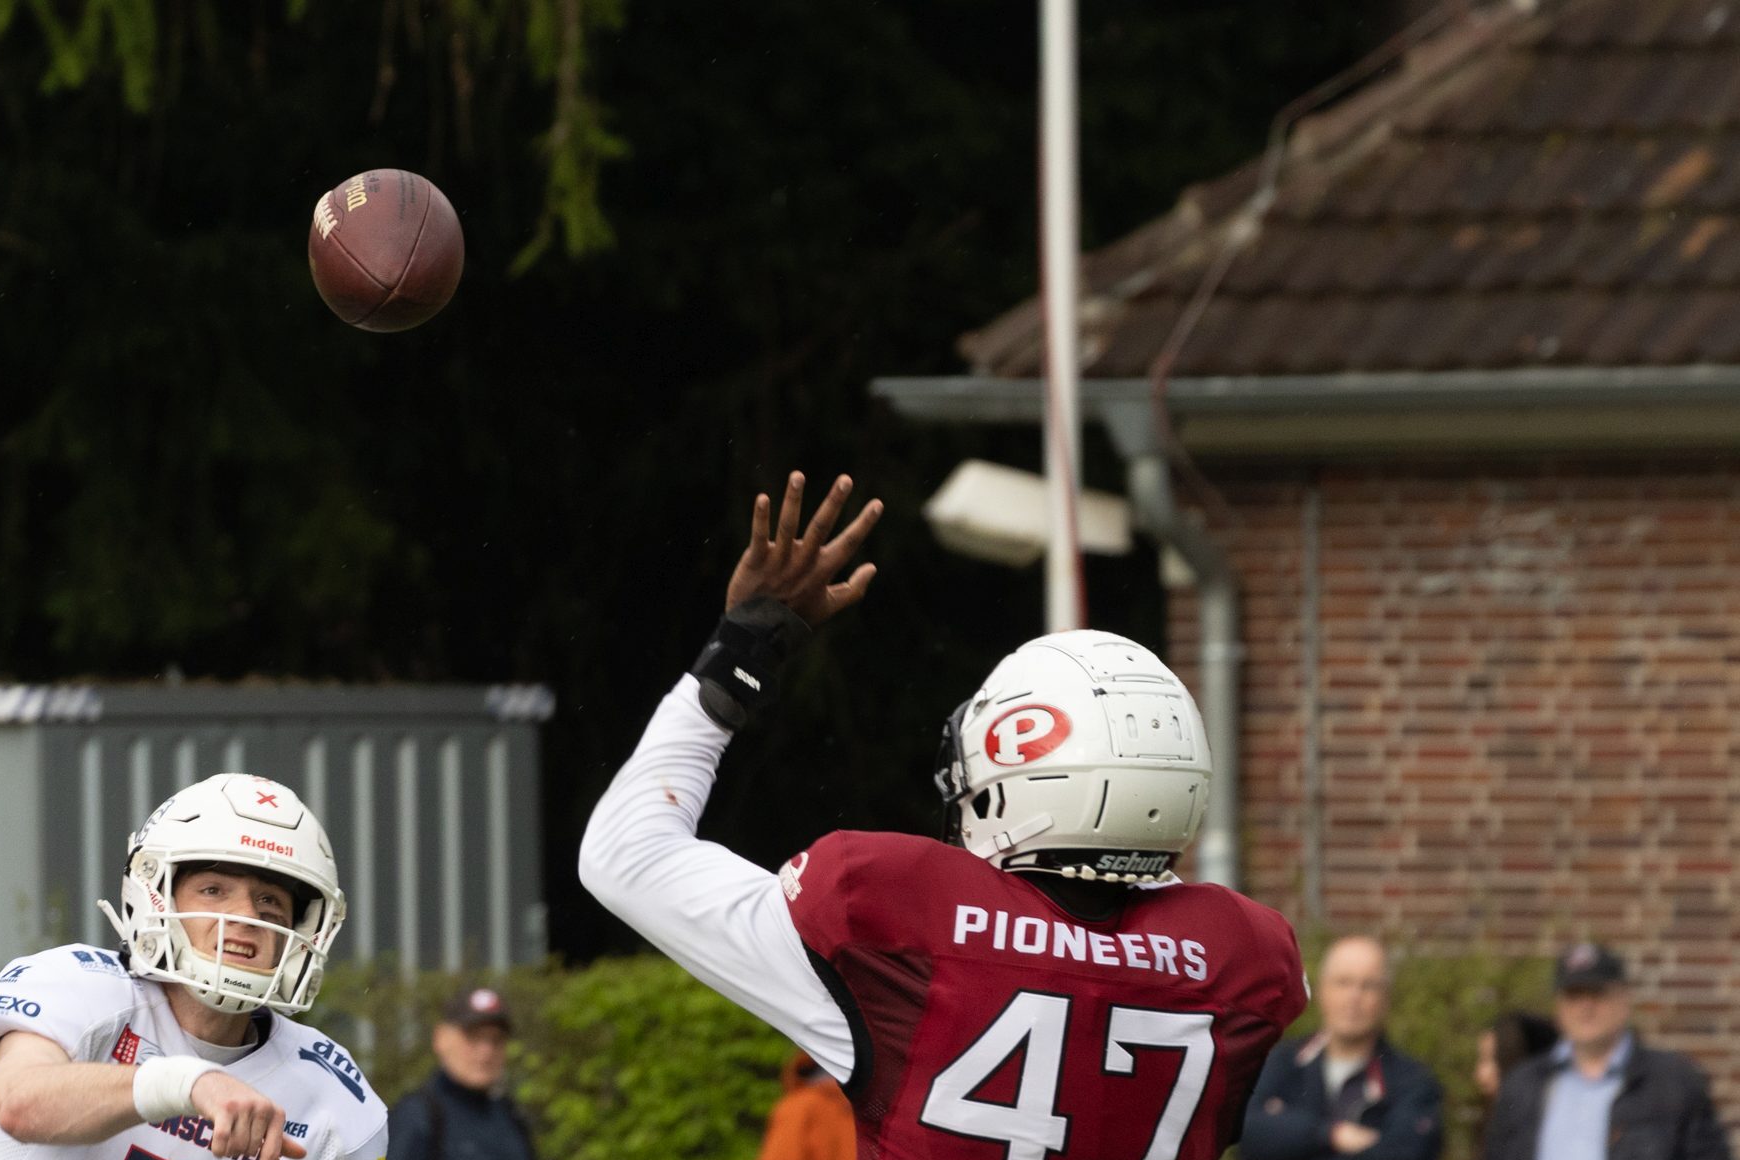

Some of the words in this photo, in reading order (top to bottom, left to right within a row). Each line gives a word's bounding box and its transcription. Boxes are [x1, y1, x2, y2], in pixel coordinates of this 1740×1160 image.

[239, 834, 294, 857] Riddell
[1096, 851, 1170, 872] schutt
[953, 904, 1208, 981] PIONEERS
[311, 1039, 362, 1084] dm
